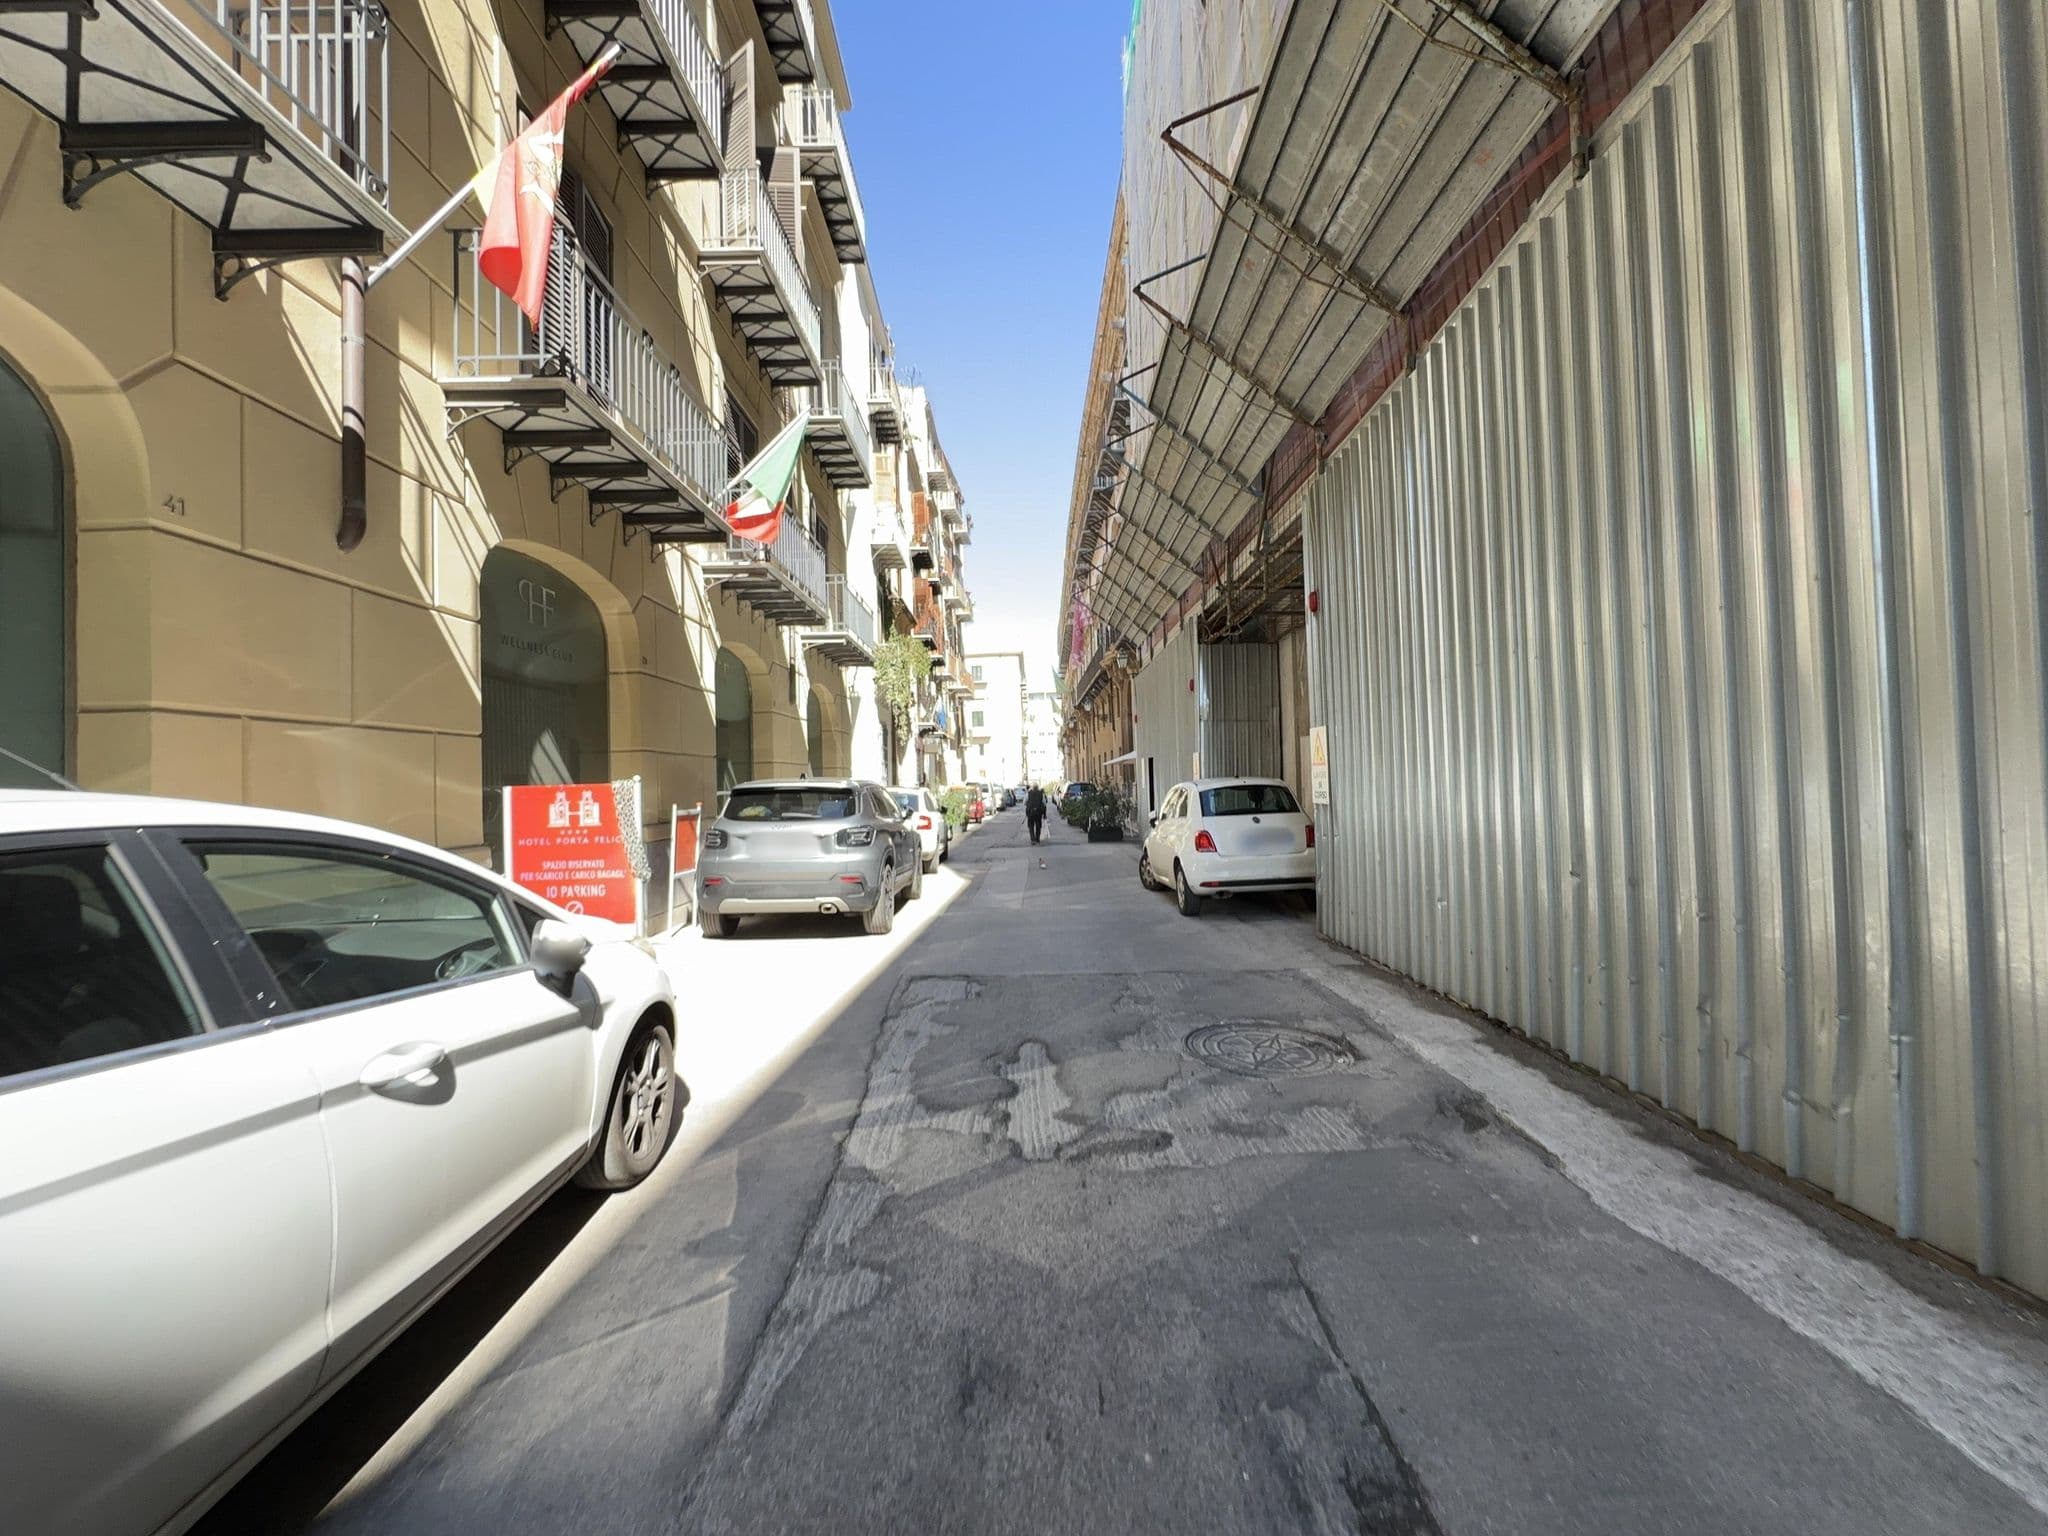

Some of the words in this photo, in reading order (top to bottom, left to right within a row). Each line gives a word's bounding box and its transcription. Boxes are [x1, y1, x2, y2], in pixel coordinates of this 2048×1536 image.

[161, 494, 185, 516] 41
[518, 837, 551, 846] HOTEL
[556, 836, 589, 845] PORTA
[594, 835, 624, 844] FELIC
[542, 860, 567, 870] SPAZIO
[568, 859, 605, 869] RISERVATO
[520, 871, 534, 881] PER
[535, 871, 564, 880] SCARICO
[571, 870, 596, 879] CARICO
[560, 884, 606, 897] PARKING
